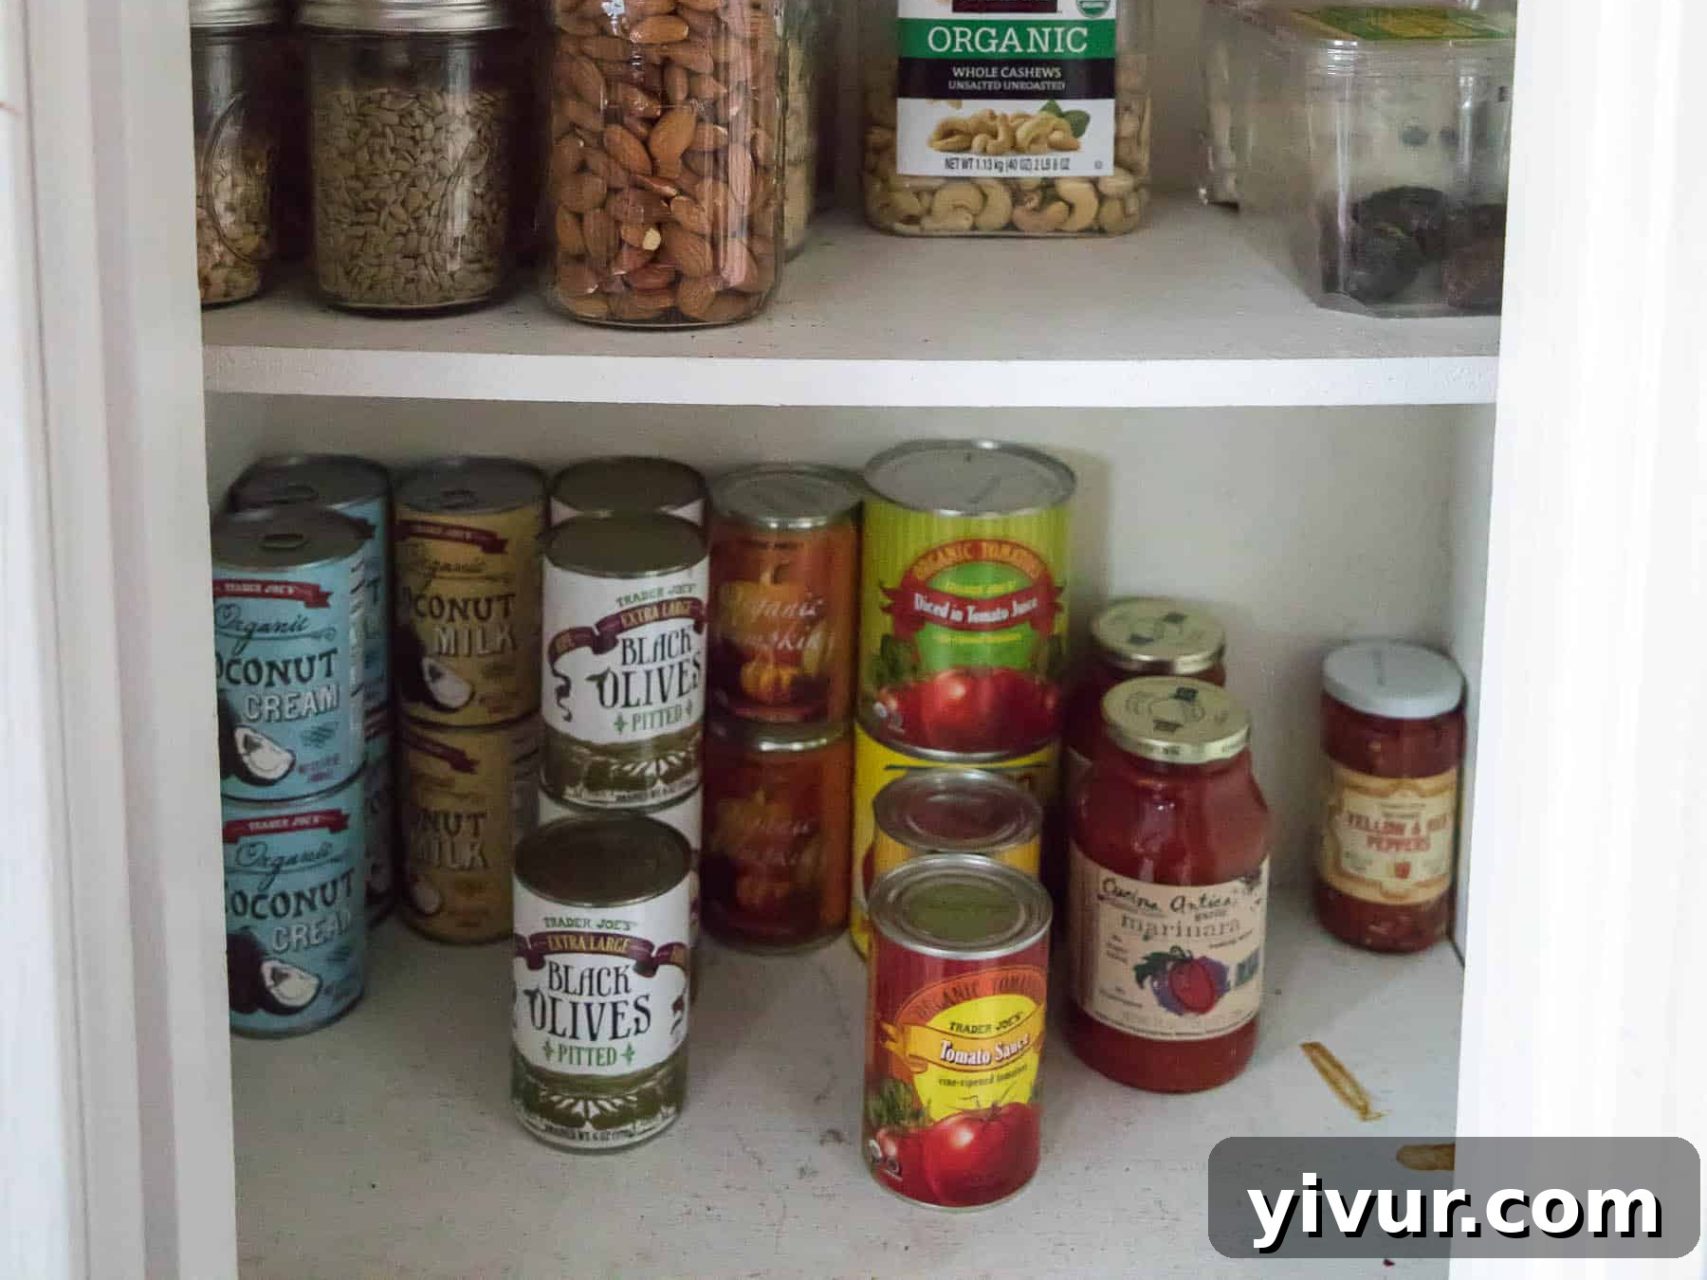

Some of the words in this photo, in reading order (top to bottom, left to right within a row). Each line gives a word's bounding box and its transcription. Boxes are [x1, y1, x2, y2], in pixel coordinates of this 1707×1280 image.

[927, 25, 1089, 53] ORGANIC
[948, 79, 1001, 91] UNSALTED
[1003, 79, 1065, 91] UNROASTED
[952, 66, 999, 79] WHOLE
[1000, 66, 1062, 79] CASHEWS
[945, 157, 960, 170] NET
[961, 157, 974, 170] WT
[616, 586, 664, 607] TRADER
[914, 593, 951, 619] Diced
[950, 603, 964, 622] in
[967, 604, 1010, 625] Tomato
[215, 602, 310, 655] Organic
[620, 605, 660, 629] EXTRA
[434, 622, 519, 658] MILK
[621, 627, 692, 667] BLACK
[596, 650, 702, 710] OLIVES
[245, 682, 341, 723] CREAM
[631, 704, 683, 733] PITTED
[235, 841, 333, 891] Organic
[225, 868, 355, 919] OCONUT
[544, 916, 592, 929] TRADER
[595, 917, 632, 931] JOE'S
[1121, 916, 1240, 938] marinara
[546, 934, 585, 952] EXTRA
[588, 937, 629, 952] LARGE
[547, 961, 632, 997] BLACK
[526, 993, 652, 1042] OLIVES
[949, 1021, 992, 1034] TRADER
[557, 1045, 618, 1067] PITTED
[939, 1039, 991, 1066] Tomato
[994, 1033, 1031, 1061] Sauce
